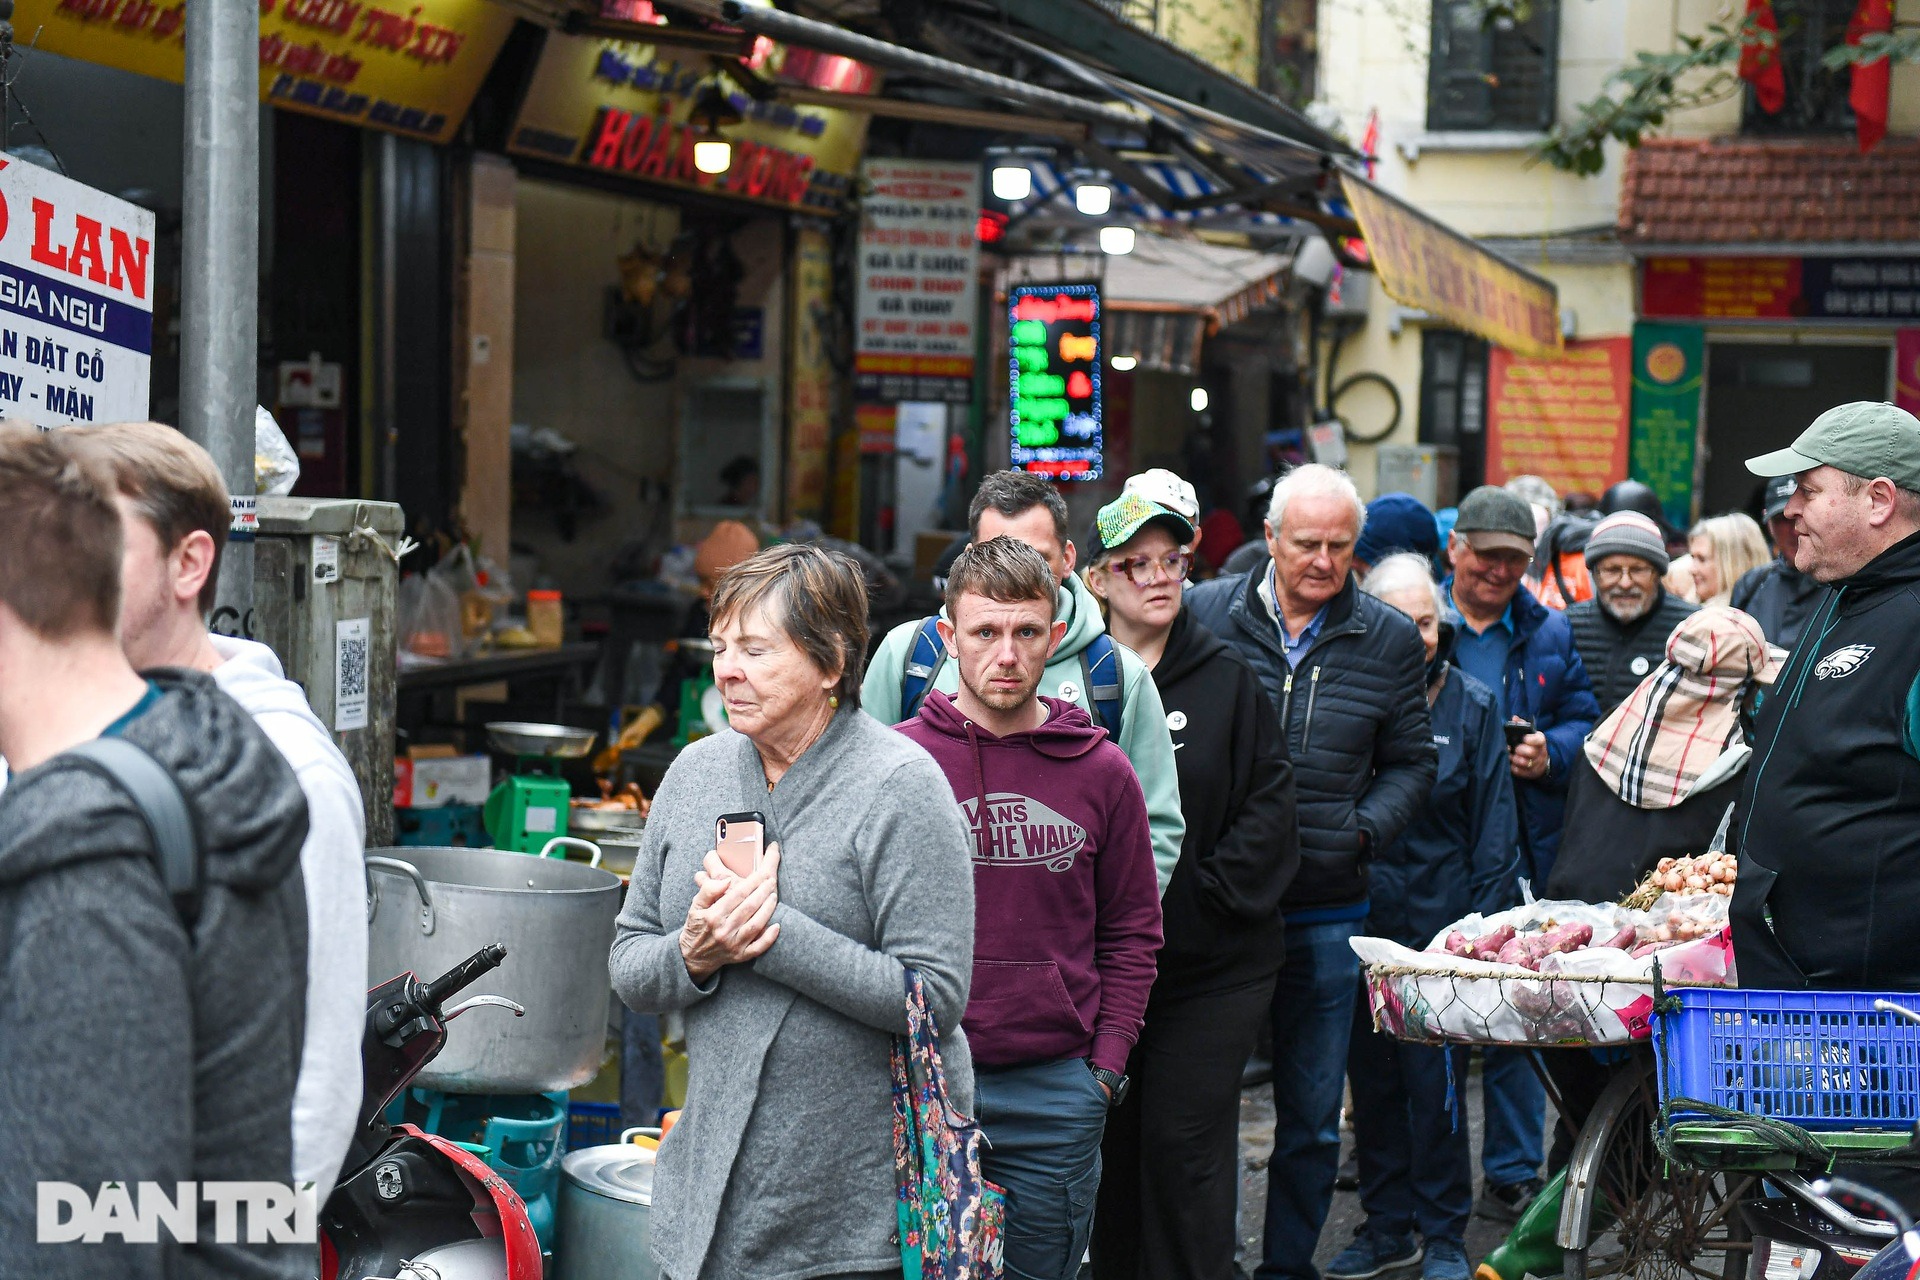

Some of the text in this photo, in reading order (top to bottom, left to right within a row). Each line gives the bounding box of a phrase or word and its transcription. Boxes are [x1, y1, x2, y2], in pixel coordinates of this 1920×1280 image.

[31, 196, 150, 300] LAN
[0, 273, 107, 333] GIA NGƯ
[25, 337, 69, 374] ĐẶT
[75, 348, 104, 383] CỖ
[46, 384, 94, 422] MẶN
[963, 803, 1029, 828] VANS
[970, 824, 1021, 859] THE
